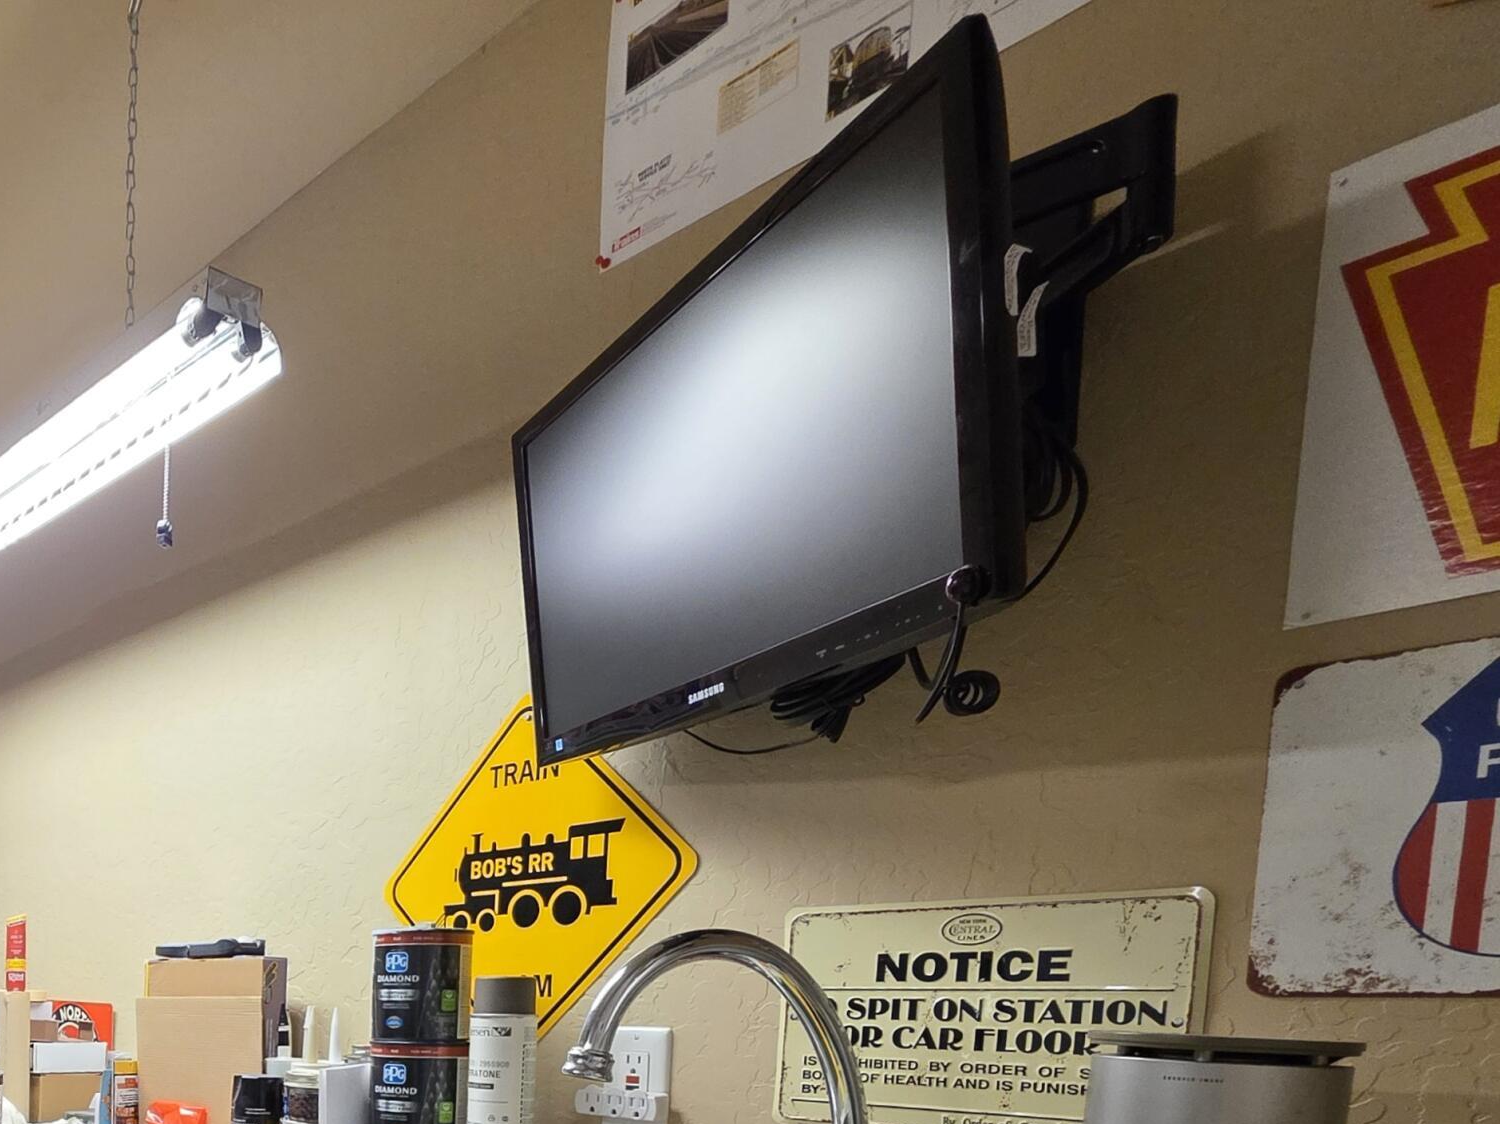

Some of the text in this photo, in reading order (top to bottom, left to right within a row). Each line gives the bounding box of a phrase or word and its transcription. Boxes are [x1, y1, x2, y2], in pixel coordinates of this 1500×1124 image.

[688, 682, 724, 705] SAMSUNG
[470, 852, 554, 880] BOB'S RR
[949, 924, 997, 937] CENTRAL
[386, 953, 408, 971] PPG
[876, 949, 1073, 982] NOTICE
[377, 974, 420, 983] DIAMOND
[847, 998, 926, 1021] SPIT
[933, 998, 984, 1022] ON
[893, 1026, 963, 1050] CAR
[384, 1064, 406, 1083] PPG
[804, 1056, 817, 1066] IS
[858, 1058, 919, 1071] HIBITED
[929, 1062, 951, 1072] BY
[960, 1062, 1027, 1076] ORDER
[1038, 1066, 1066, 1078] OF
[374, 1085, 418, 1096] DIAMOND
[884, 1074, 948, 1088] HEALTH
[953, 1078, 990, 1090] AND
[996, 1080, 1012, 1091] IS
